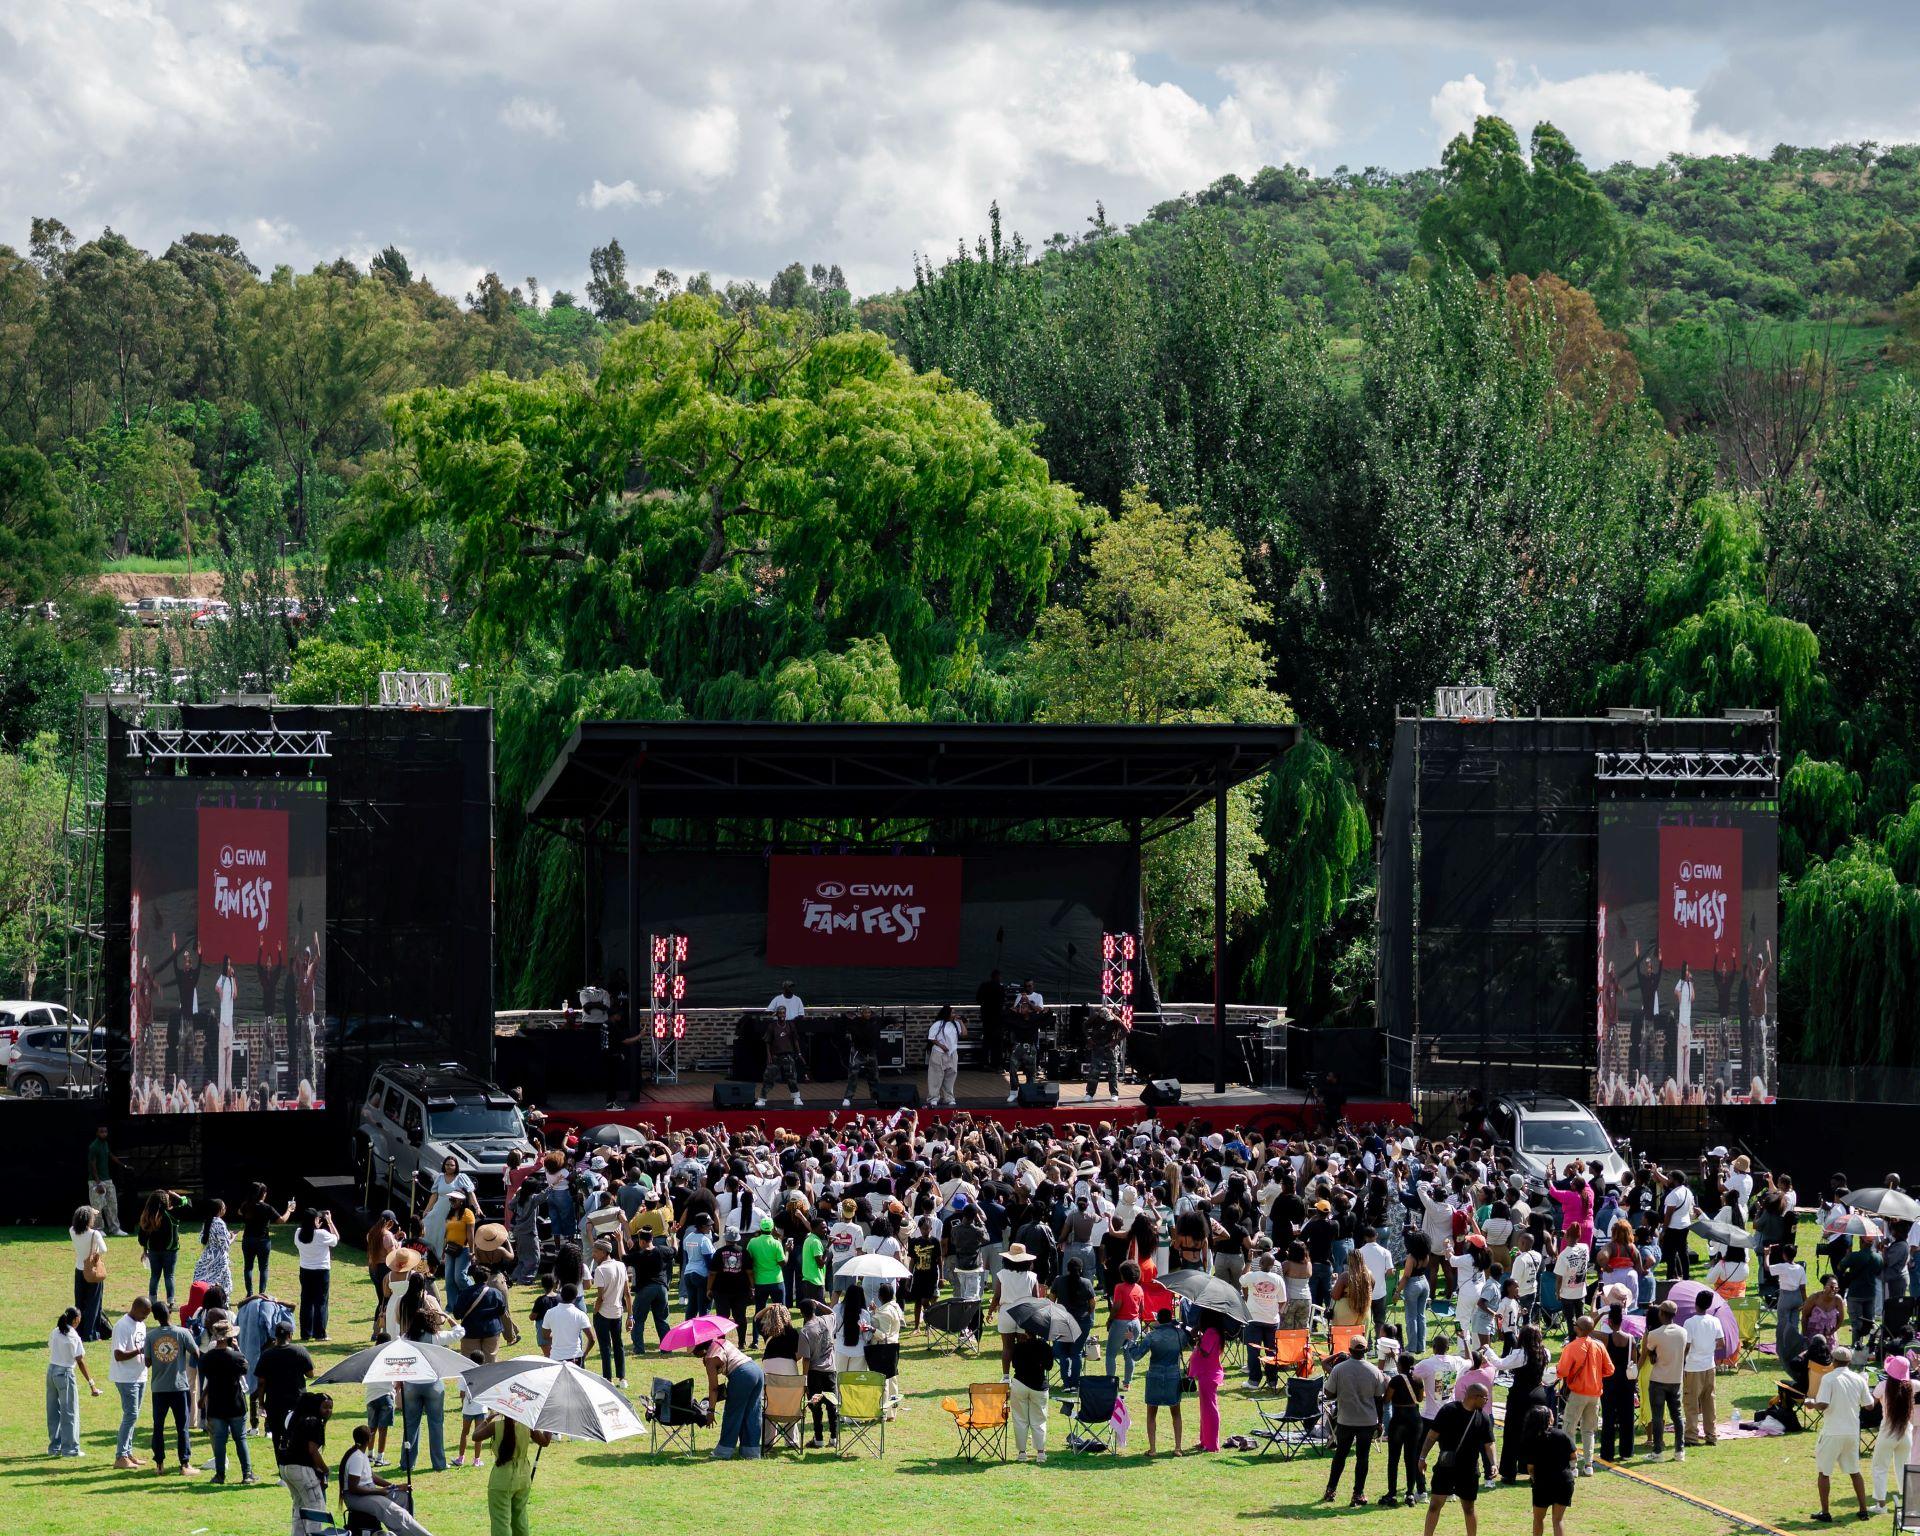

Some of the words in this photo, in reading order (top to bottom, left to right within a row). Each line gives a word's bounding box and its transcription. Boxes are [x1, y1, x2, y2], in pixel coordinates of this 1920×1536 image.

[236, 849, 266, 865] GWM
[1694, 864, 1722, 879] GWM
[850, 884, 913, 896] GWM
